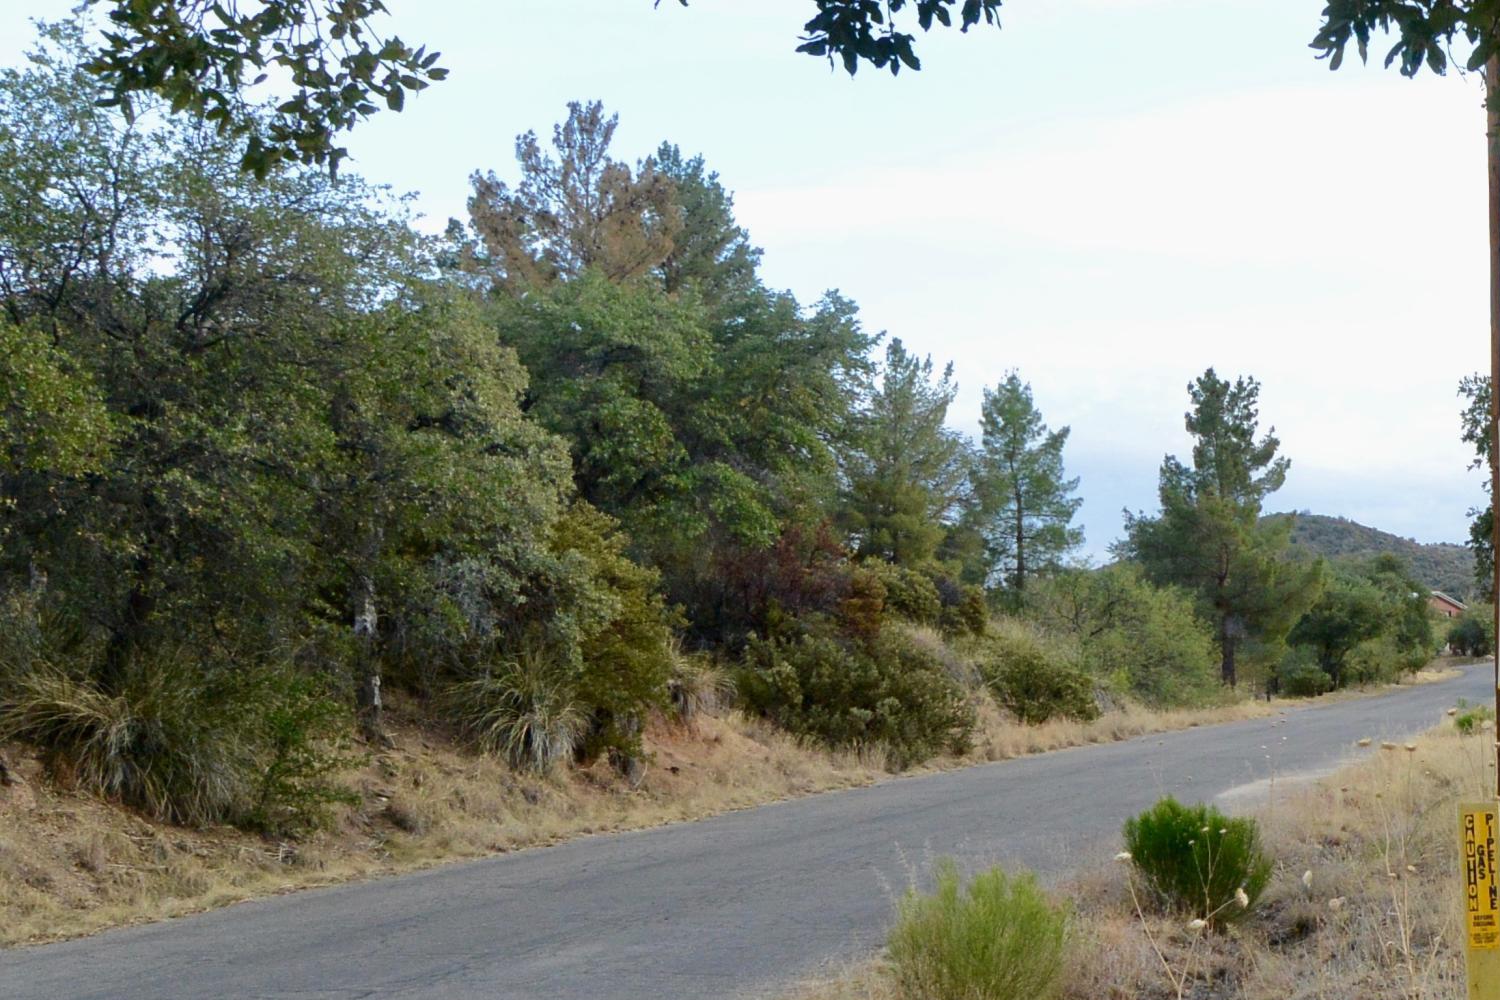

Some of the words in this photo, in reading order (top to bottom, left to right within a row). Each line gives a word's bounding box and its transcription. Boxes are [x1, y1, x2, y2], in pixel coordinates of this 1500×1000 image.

[1465, 815, 1478, 911] CAUTION
[1477, 845, 1486, 880] GAS
[1485, 813, 1497, 910] PIPELINE
